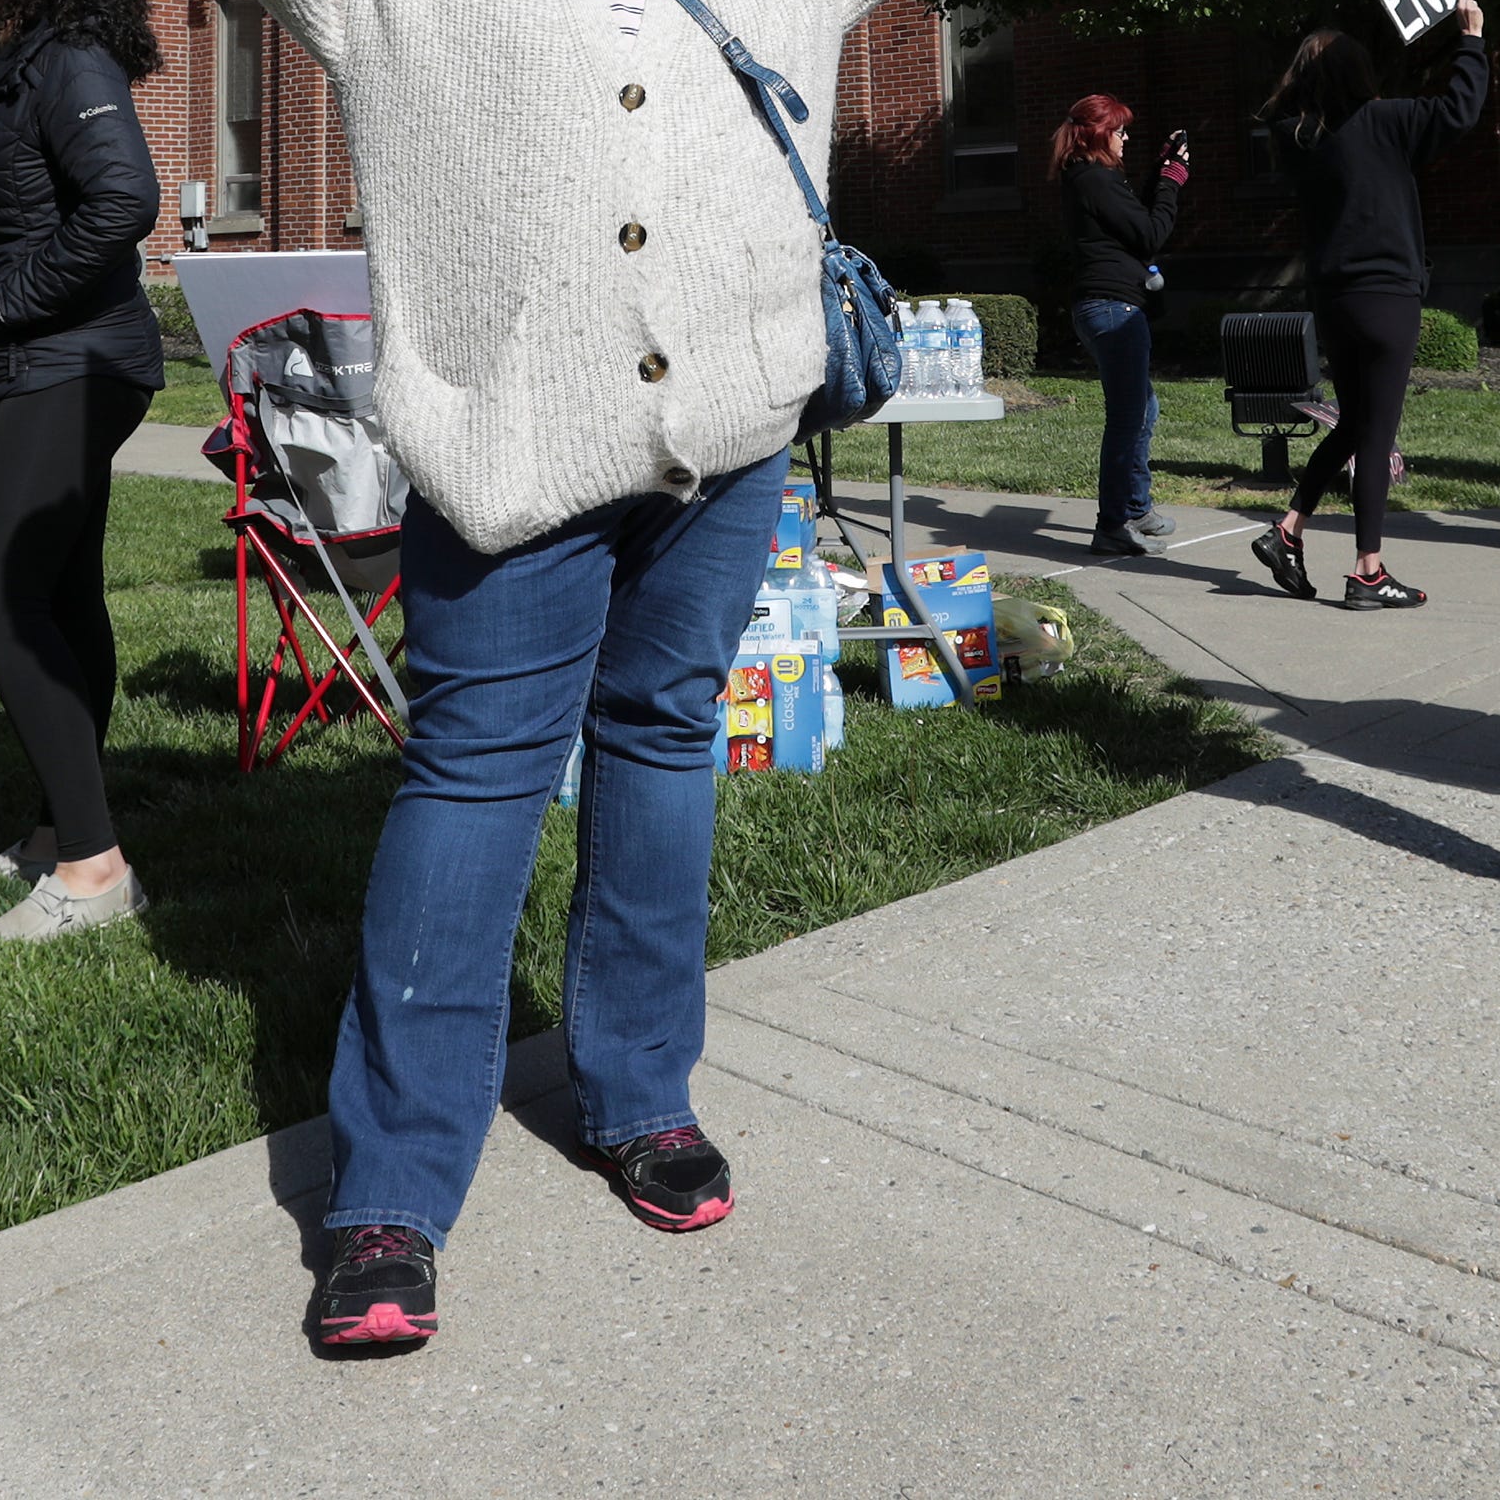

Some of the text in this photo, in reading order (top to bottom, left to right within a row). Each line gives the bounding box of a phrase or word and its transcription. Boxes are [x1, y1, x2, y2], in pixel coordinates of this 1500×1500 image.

[345, 361, 374, 376] TRA
[776, 659, 793, 675] 10
[781, 684, 795, 731] classic
